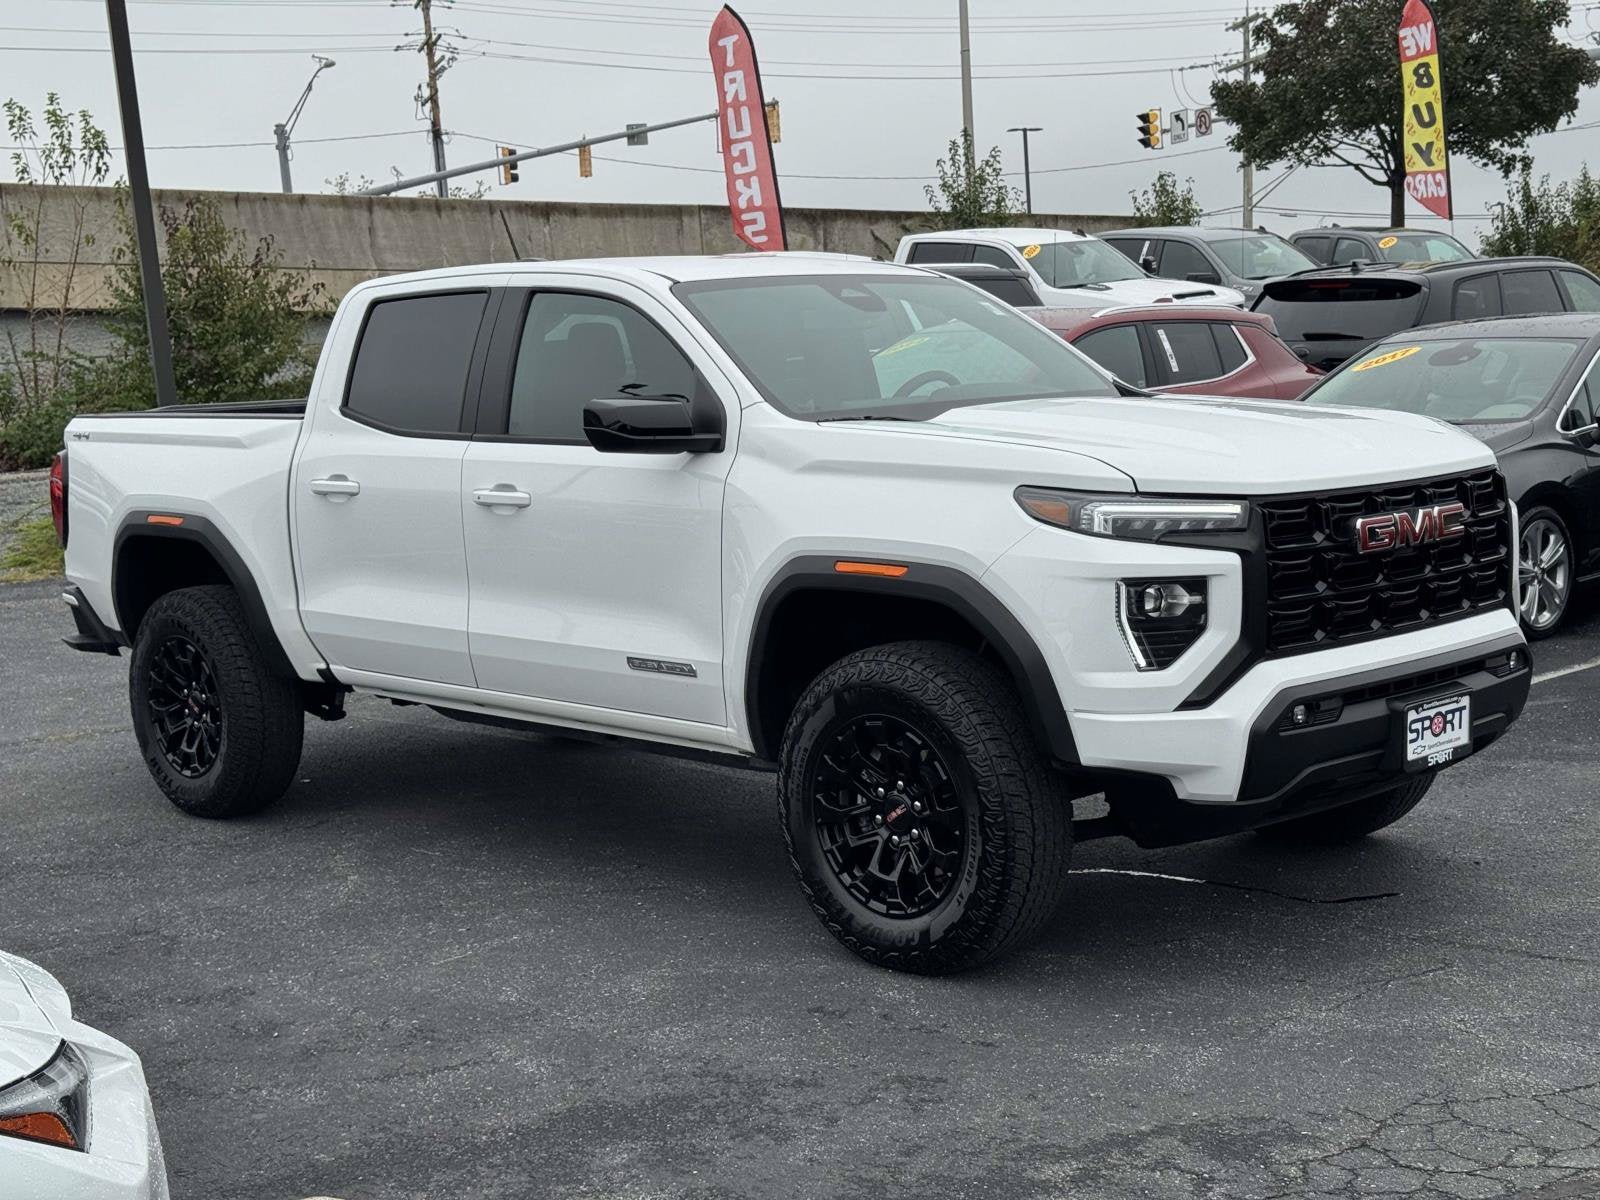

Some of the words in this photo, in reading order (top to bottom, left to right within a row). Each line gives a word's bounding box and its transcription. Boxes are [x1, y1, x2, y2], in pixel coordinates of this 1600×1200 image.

[1361, 347, 1414, 369] 2017
[1356, 503, 1465, 554] GMC
[1409, 705, 1467, 744] SPORT
[1427, 748, 1454, 767] SPORT
